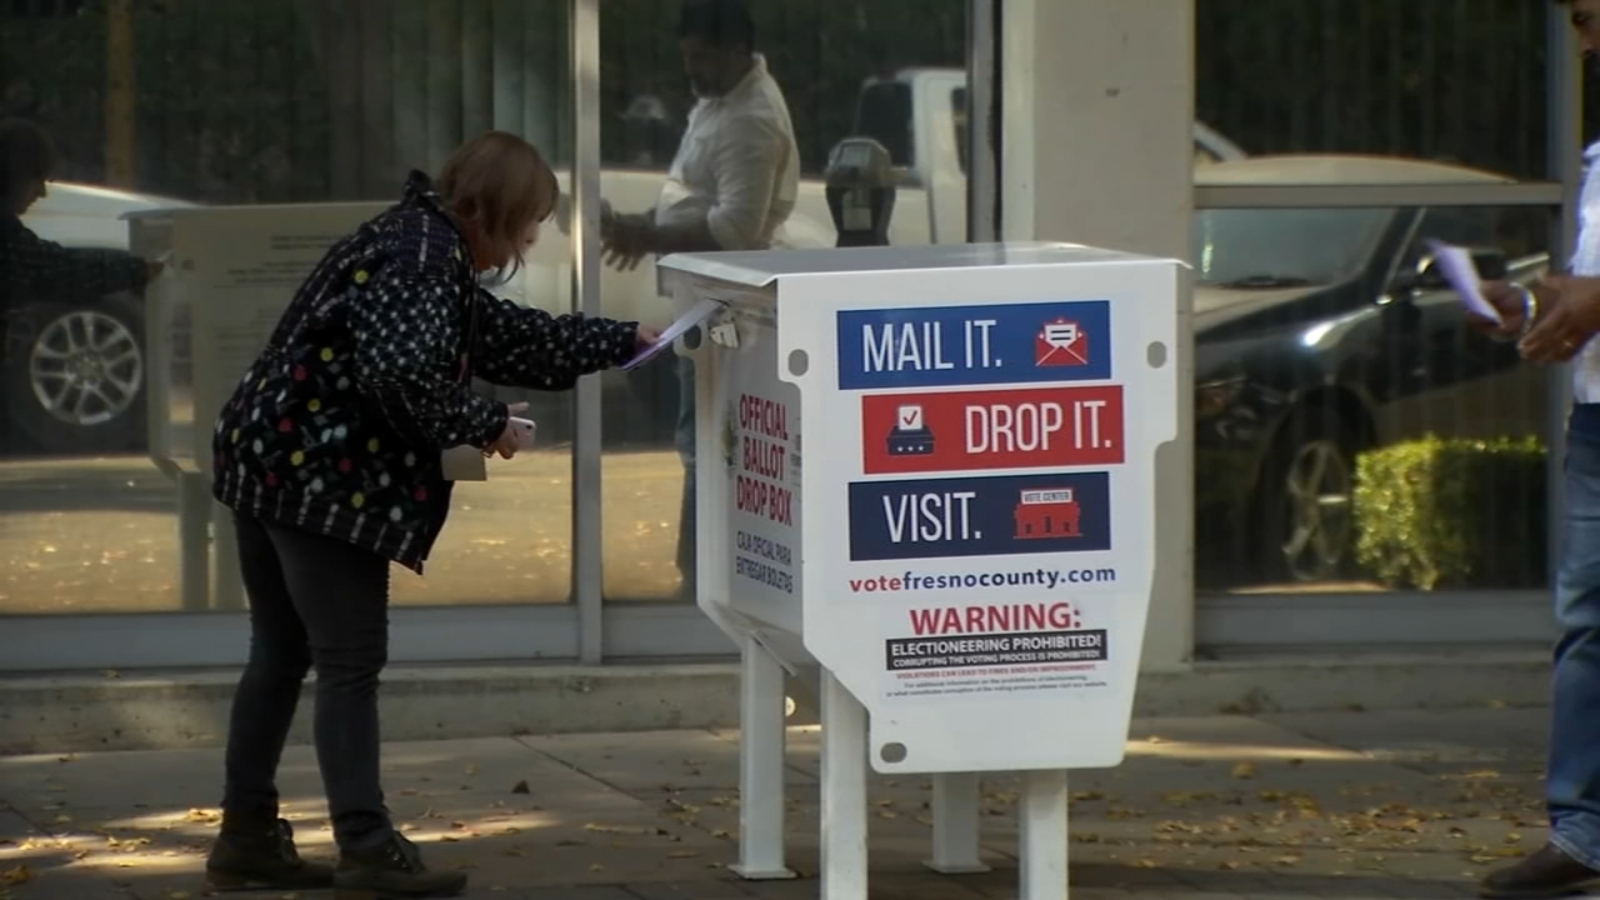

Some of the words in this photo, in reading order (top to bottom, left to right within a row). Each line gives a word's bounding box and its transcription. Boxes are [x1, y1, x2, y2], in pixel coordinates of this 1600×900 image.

[863, 321, 954, 373] MAIL
[965, 319, 1002, 369] IT.
[740, 393, 788, 441] OFFICIAL
[965, 402, 1063, 454] DROP
[1074, 401, 1112, 450] IT.
[744, 435, 785, 481] BALLOT
[736, 474, 767, 516] DROP
[769, 484, 792, 527] BOX
[882, 491, 982, 543] VISIT.
[849, 567, 1116, 593] votefresnocounty.com
[909, 602, 1082, 636] WARNING:
[891, 638, 1010, 657] ELECTIONEERING
[1012, 634, 1102, 651] PROHIBITED!
[893, 657, 947, 668] CORRUPTING
[949, 655, 965, 665] THE
[967, 654, 998, 664] VOTING
[1000, 652, 1036, 662] PROCESS
[1038, 651, 1046, 661] IS
